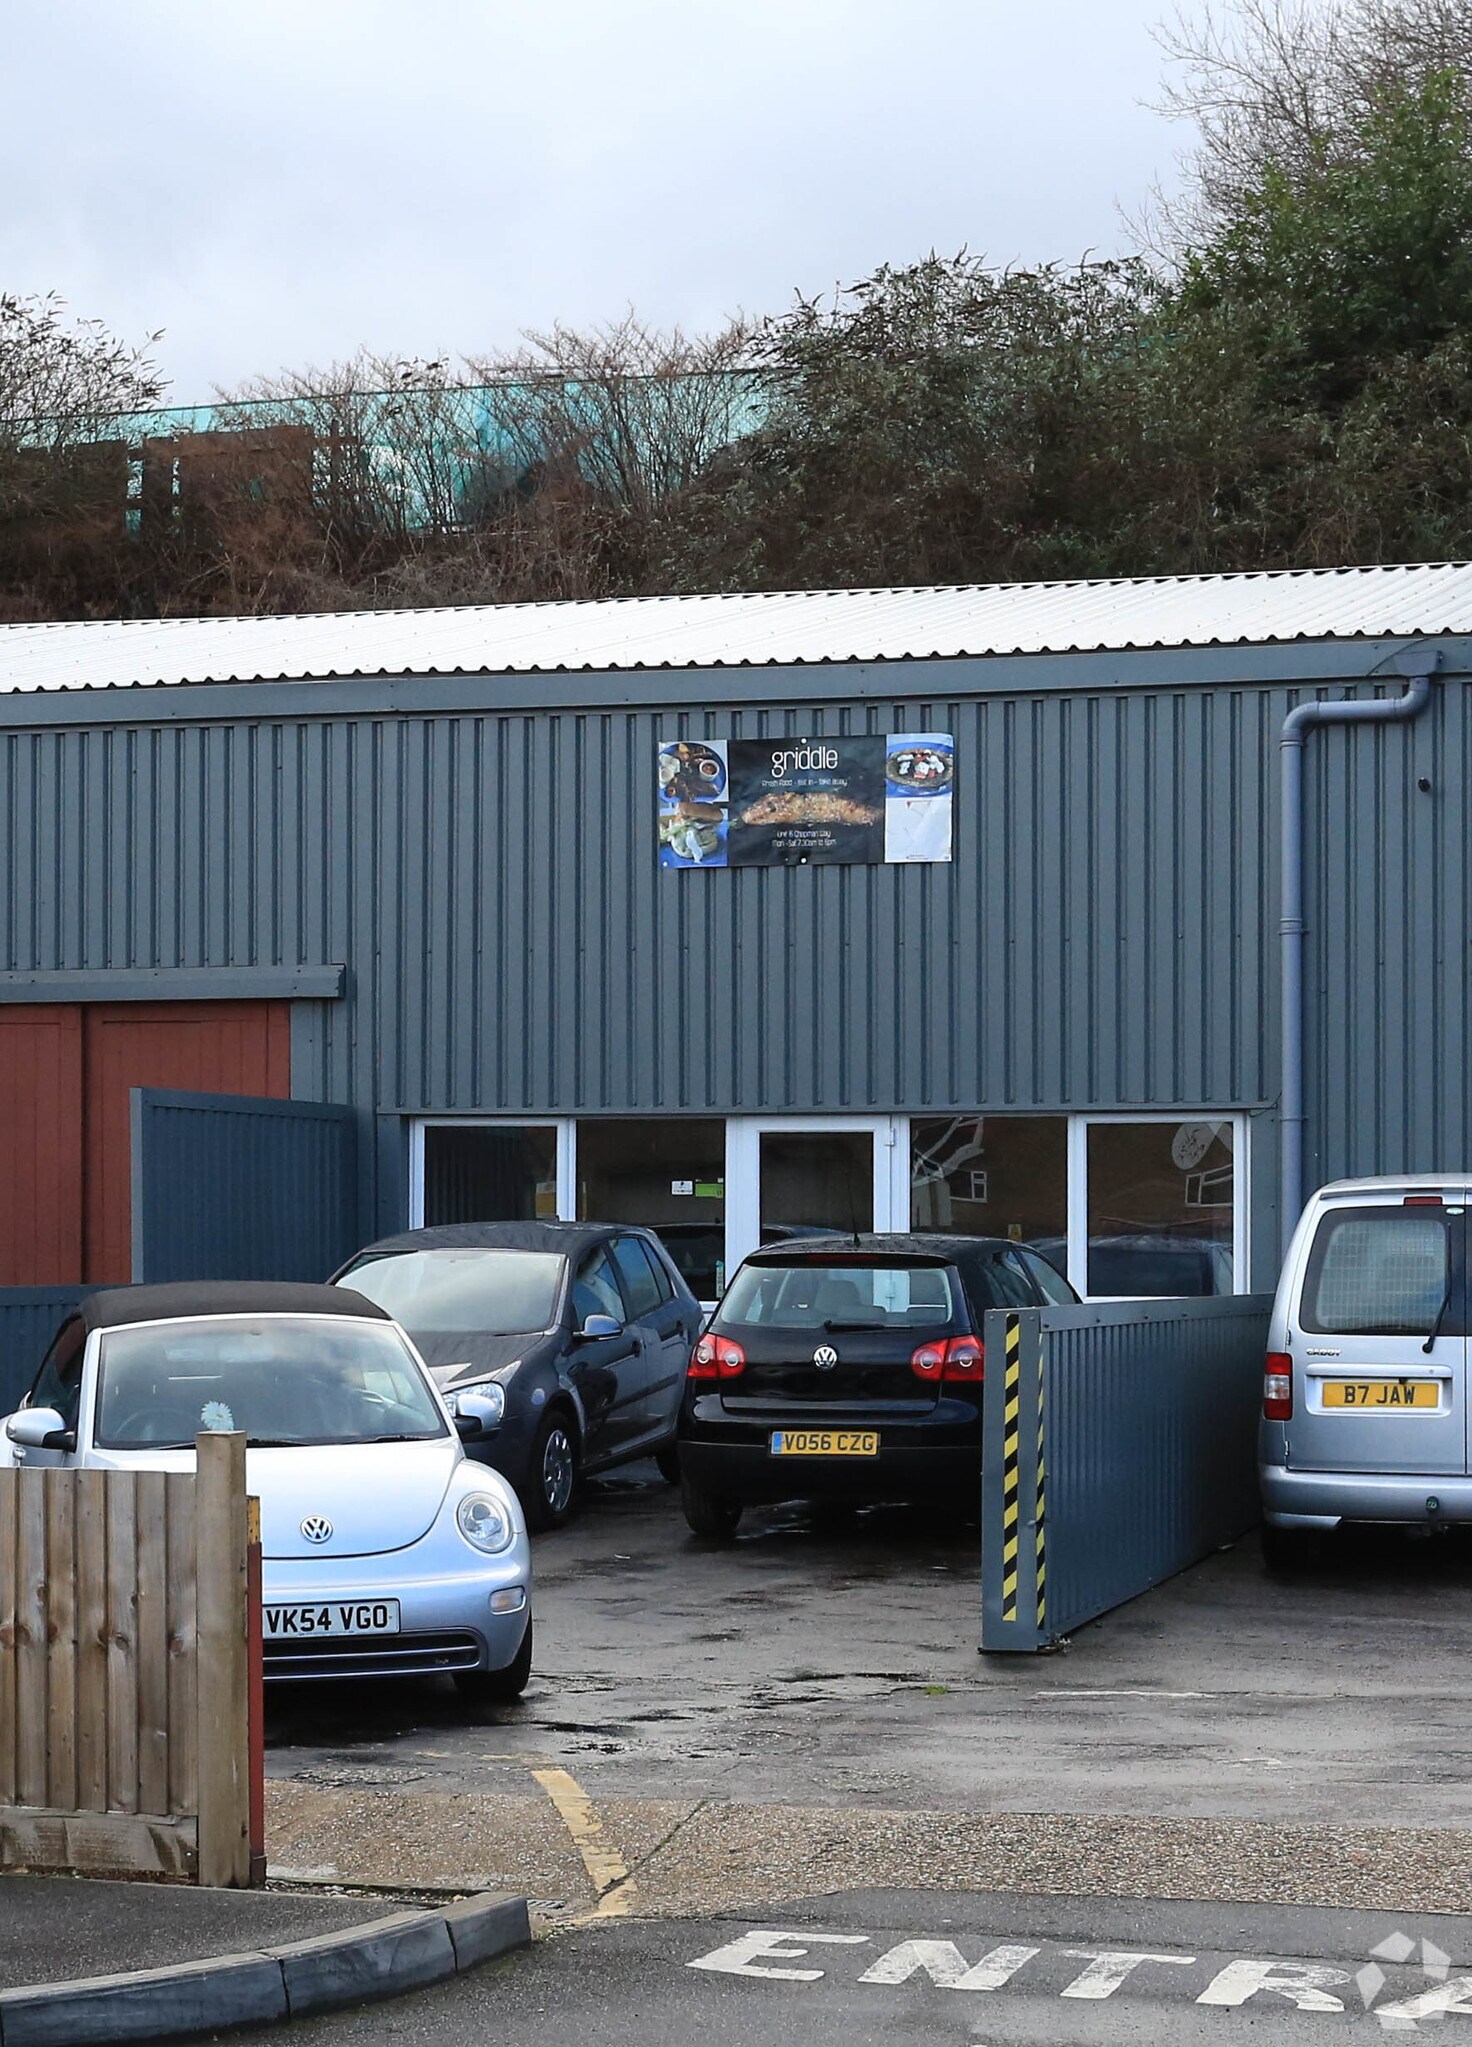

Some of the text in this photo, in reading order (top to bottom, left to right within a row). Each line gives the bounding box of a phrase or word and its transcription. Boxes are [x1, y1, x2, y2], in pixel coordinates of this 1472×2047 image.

[771, 746, 838, 778] griddle
[1344, 1385, 1415, 1404] B7 JAW
[784, 1433, 874, 1451] VO56 CZG
[265, 1604, 388, 1634] VK54 VGO
